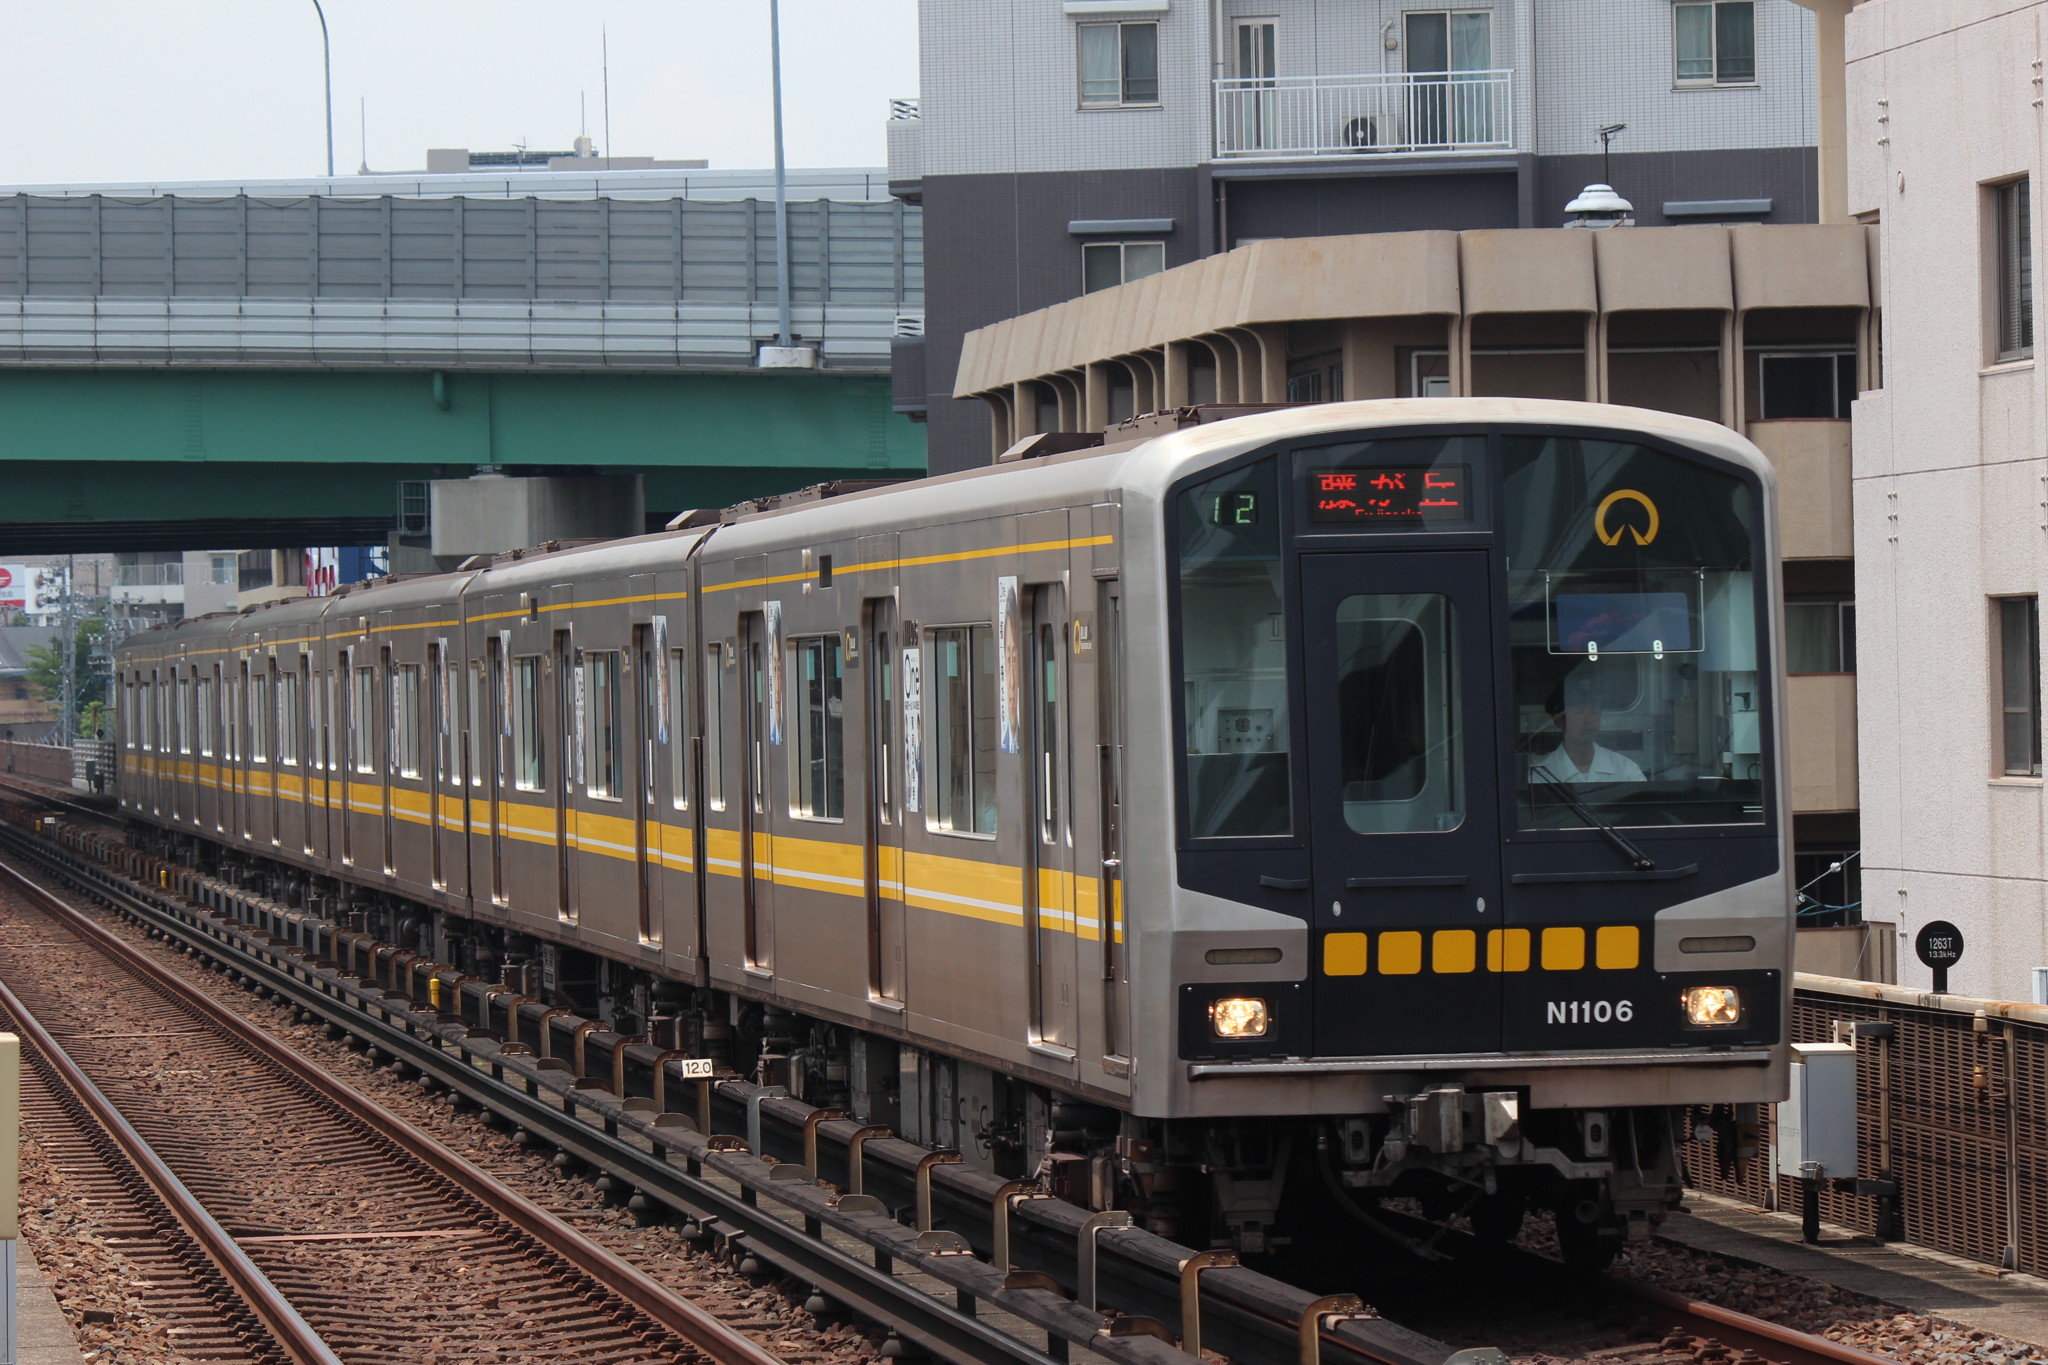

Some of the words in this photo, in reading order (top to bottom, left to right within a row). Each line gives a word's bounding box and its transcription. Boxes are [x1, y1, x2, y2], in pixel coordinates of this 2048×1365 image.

[1928, 937, 1953, 950] 1263T
[1928, 950, 1957, 959] 13.3kHz
[1547, 1000, 1633, 1024] N1106
[685, 1061, 712, 1075] 12.0
